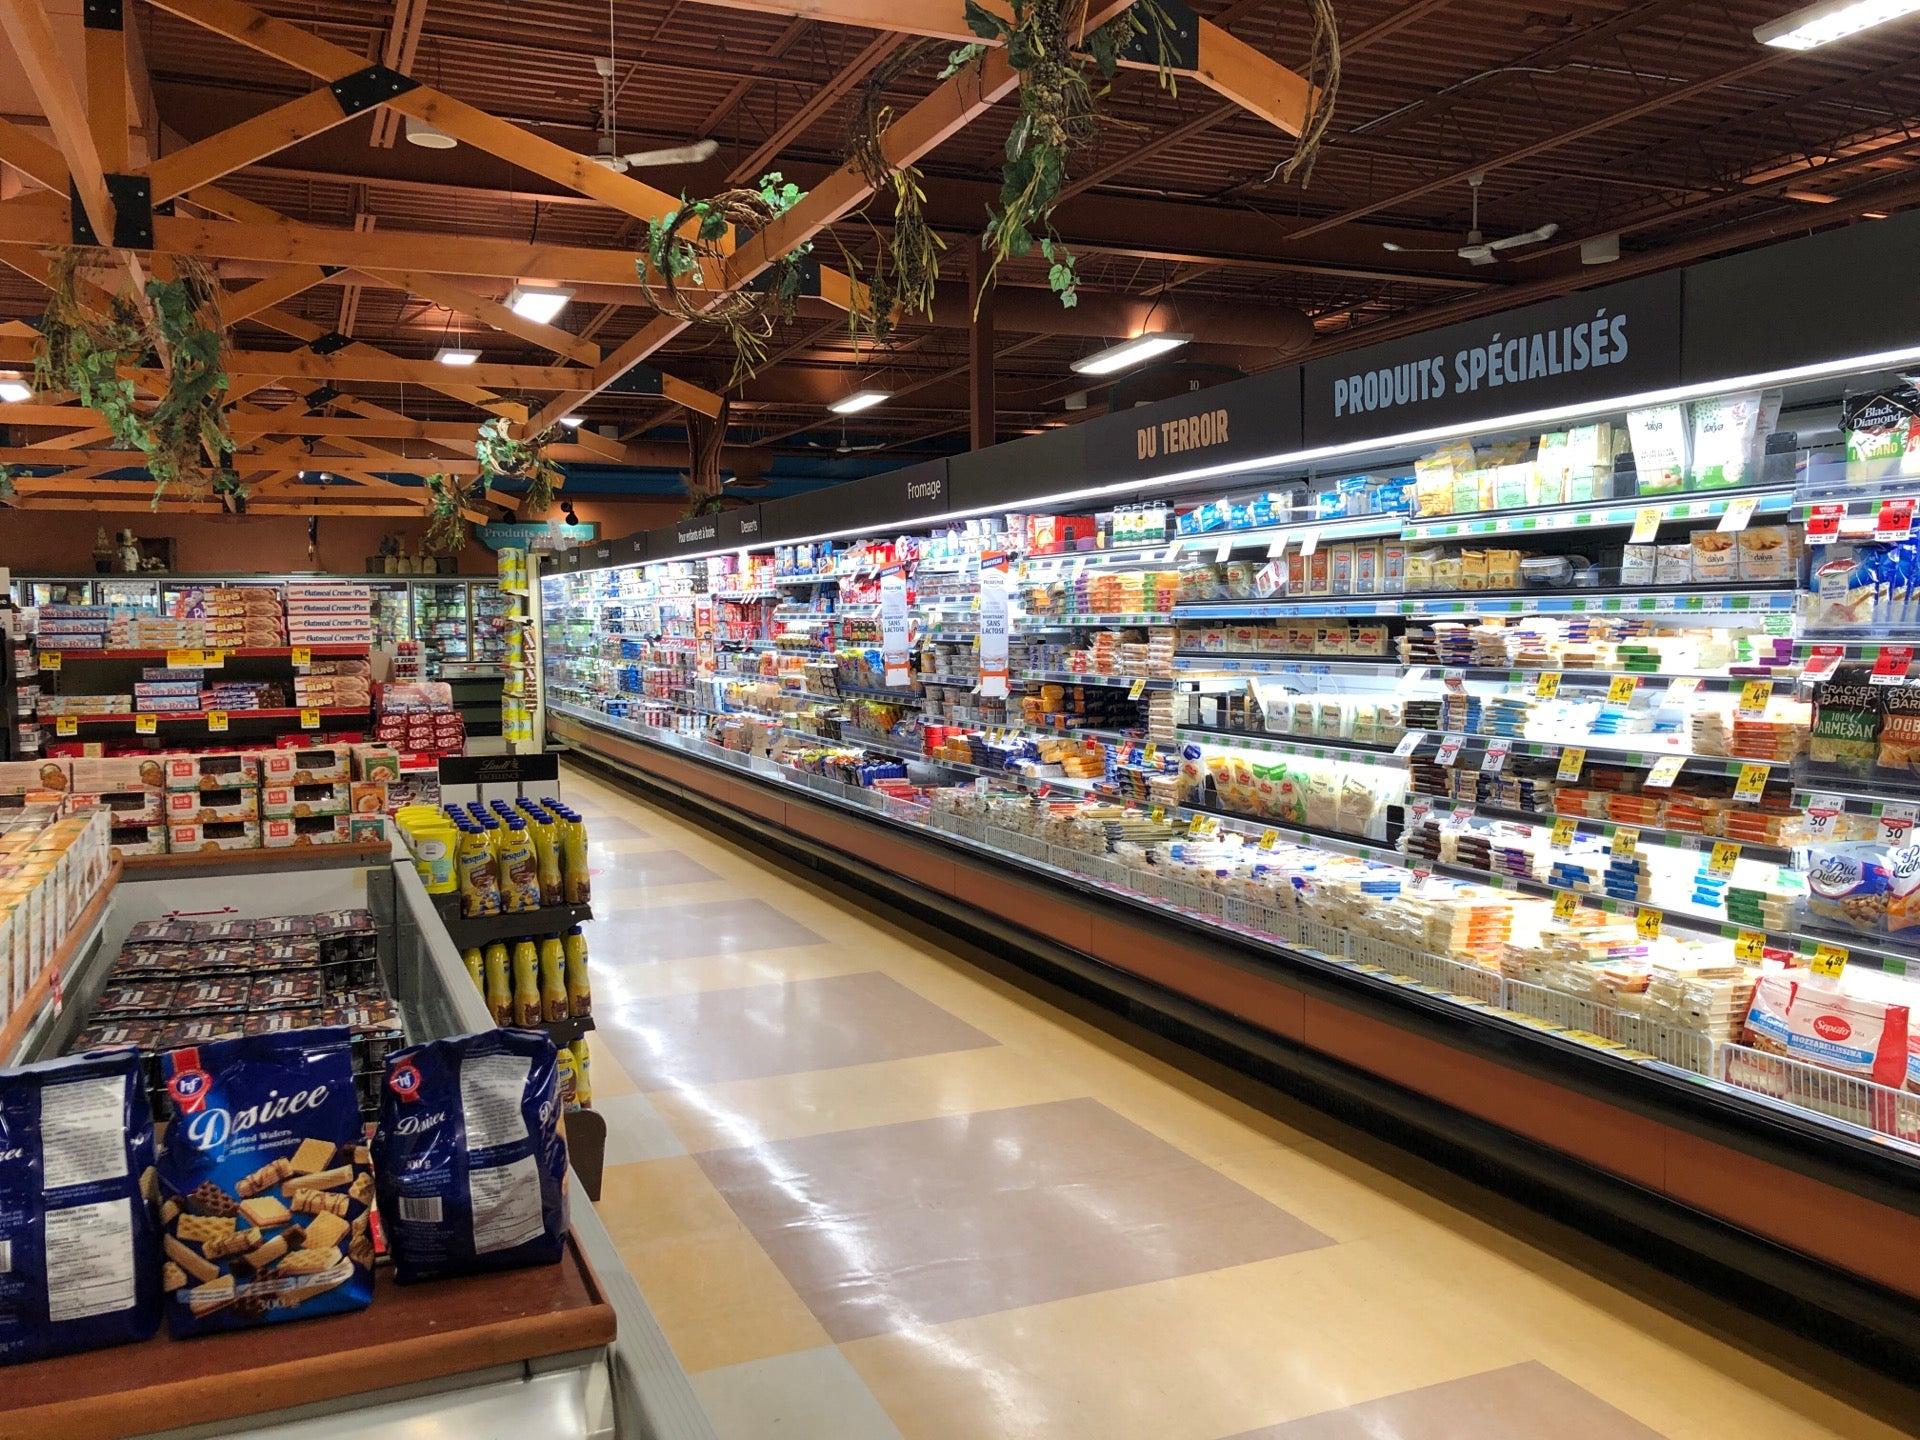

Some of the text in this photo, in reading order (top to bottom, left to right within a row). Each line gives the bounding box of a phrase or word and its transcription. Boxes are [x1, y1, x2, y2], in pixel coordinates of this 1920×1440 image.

[1334, 308, 1629, 418] PRODUITS SPÉCIALISÉS
[1189, 380, 1200, 391] 10
[1864, 404, 1894, 418] Black
[1852, 412, 1901, 429] Diamond
[1137, 409, 1229, 460] DU TERROIR
[908, 480, 941, 500] Fromage
[741, 520, 757, 533] Desserts
[485, 529, 532, 538] Produits
[1707, 553, 1724, 563] daiya
[1754, 552, 1773, 562] daiya
[215, 593, 240, 601] BUNS
[304, 588, 367, 597] Oatmeal Creme Pies
[218, 606, 244, 616] BUNS
[303, 603, 367, 612] Oatmeal Creme Pies
[217, 621, 243, 632] BUNS
[303, 619, 330, 627] Oatmeal
[354, 618, 368, 626] Pies
[217, 636, 243, 647] BUNS
[306, 634, 333, 642] Oatmeal
[355, 632, 370, 640] Pies
[311, 665, 336, 674] BUNS
[307, 681, 332, 692] BUNS
[1820, 683, 1877, 698] CRACKER
[308, 696, 333, 706] BUNS
[1822, 694, 1871, 707] BARREL
[1810, 816, 1827, 826] 50
[1886, 828, 1903, 839] 50
[461, 851, 488, 865] Nesquik
[501, 850, 528, 862] Nesquik
[1810, 868, 1856, 886] Québec
[1825, 955, 1845, 969] 499
[1815, 1020, 1850, 1036] Saputo
[1791, 1034, 1862, 1059] MOZZARELLISSIMA
[180, 1078, 201, 1093] hf
[188, 1084, 330, 1150] Desiree
[260, 1129, 292, 1140] Wafers
[47, 1209, 77, 1218] Nutrition
